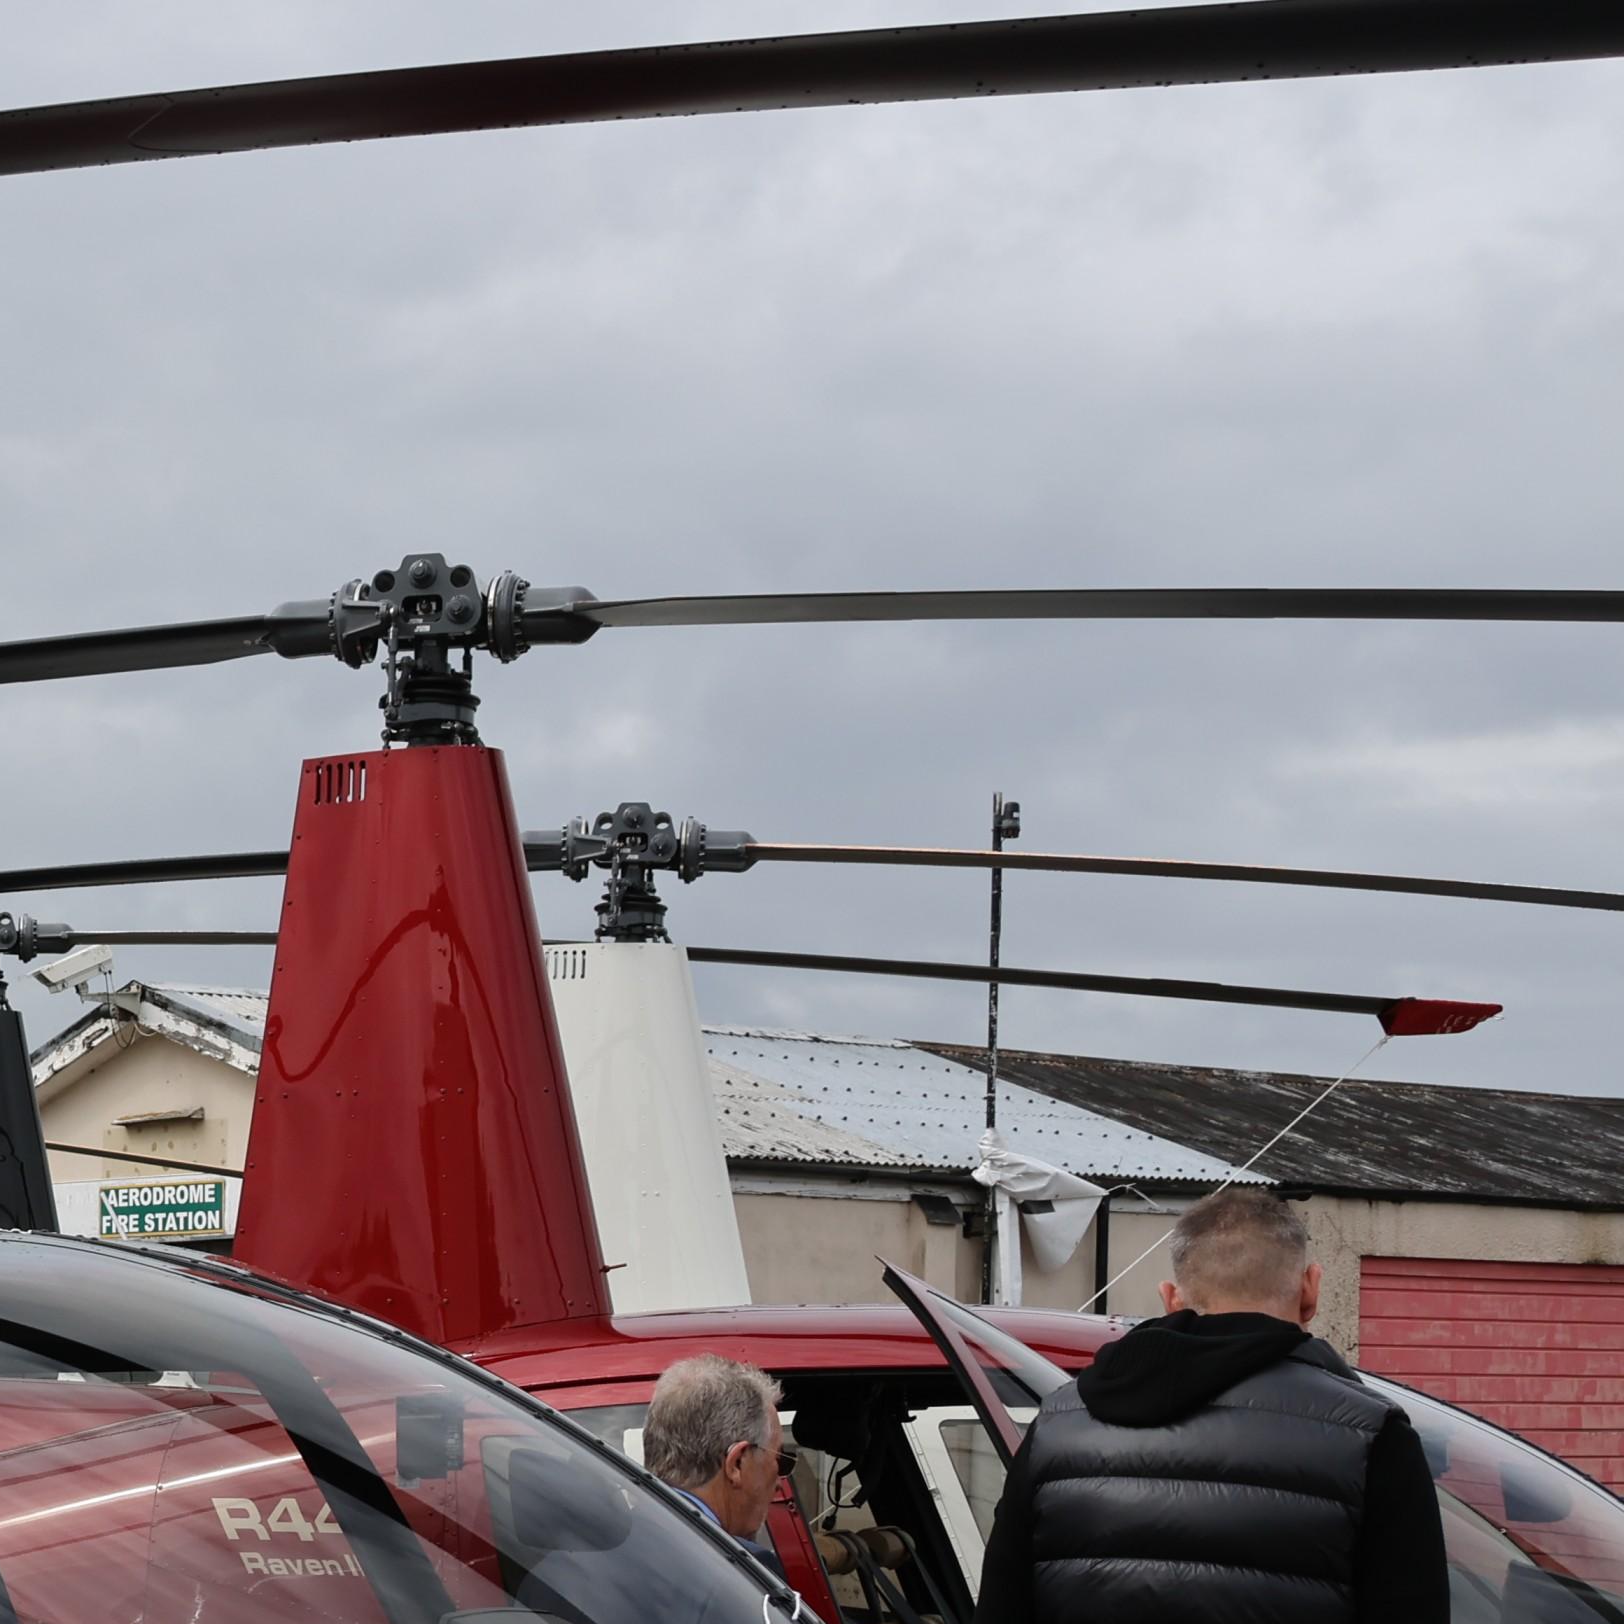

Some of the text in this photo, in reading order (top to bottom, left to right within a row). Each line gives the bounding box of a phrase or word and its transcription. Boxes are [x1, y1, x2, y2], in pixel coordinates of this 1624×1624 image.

[108, 1184, 215, 1208] AERODROME
[102, 1211, 220, 1234] FIRE STATION
[240, 1552, 344, 1576] Raven
